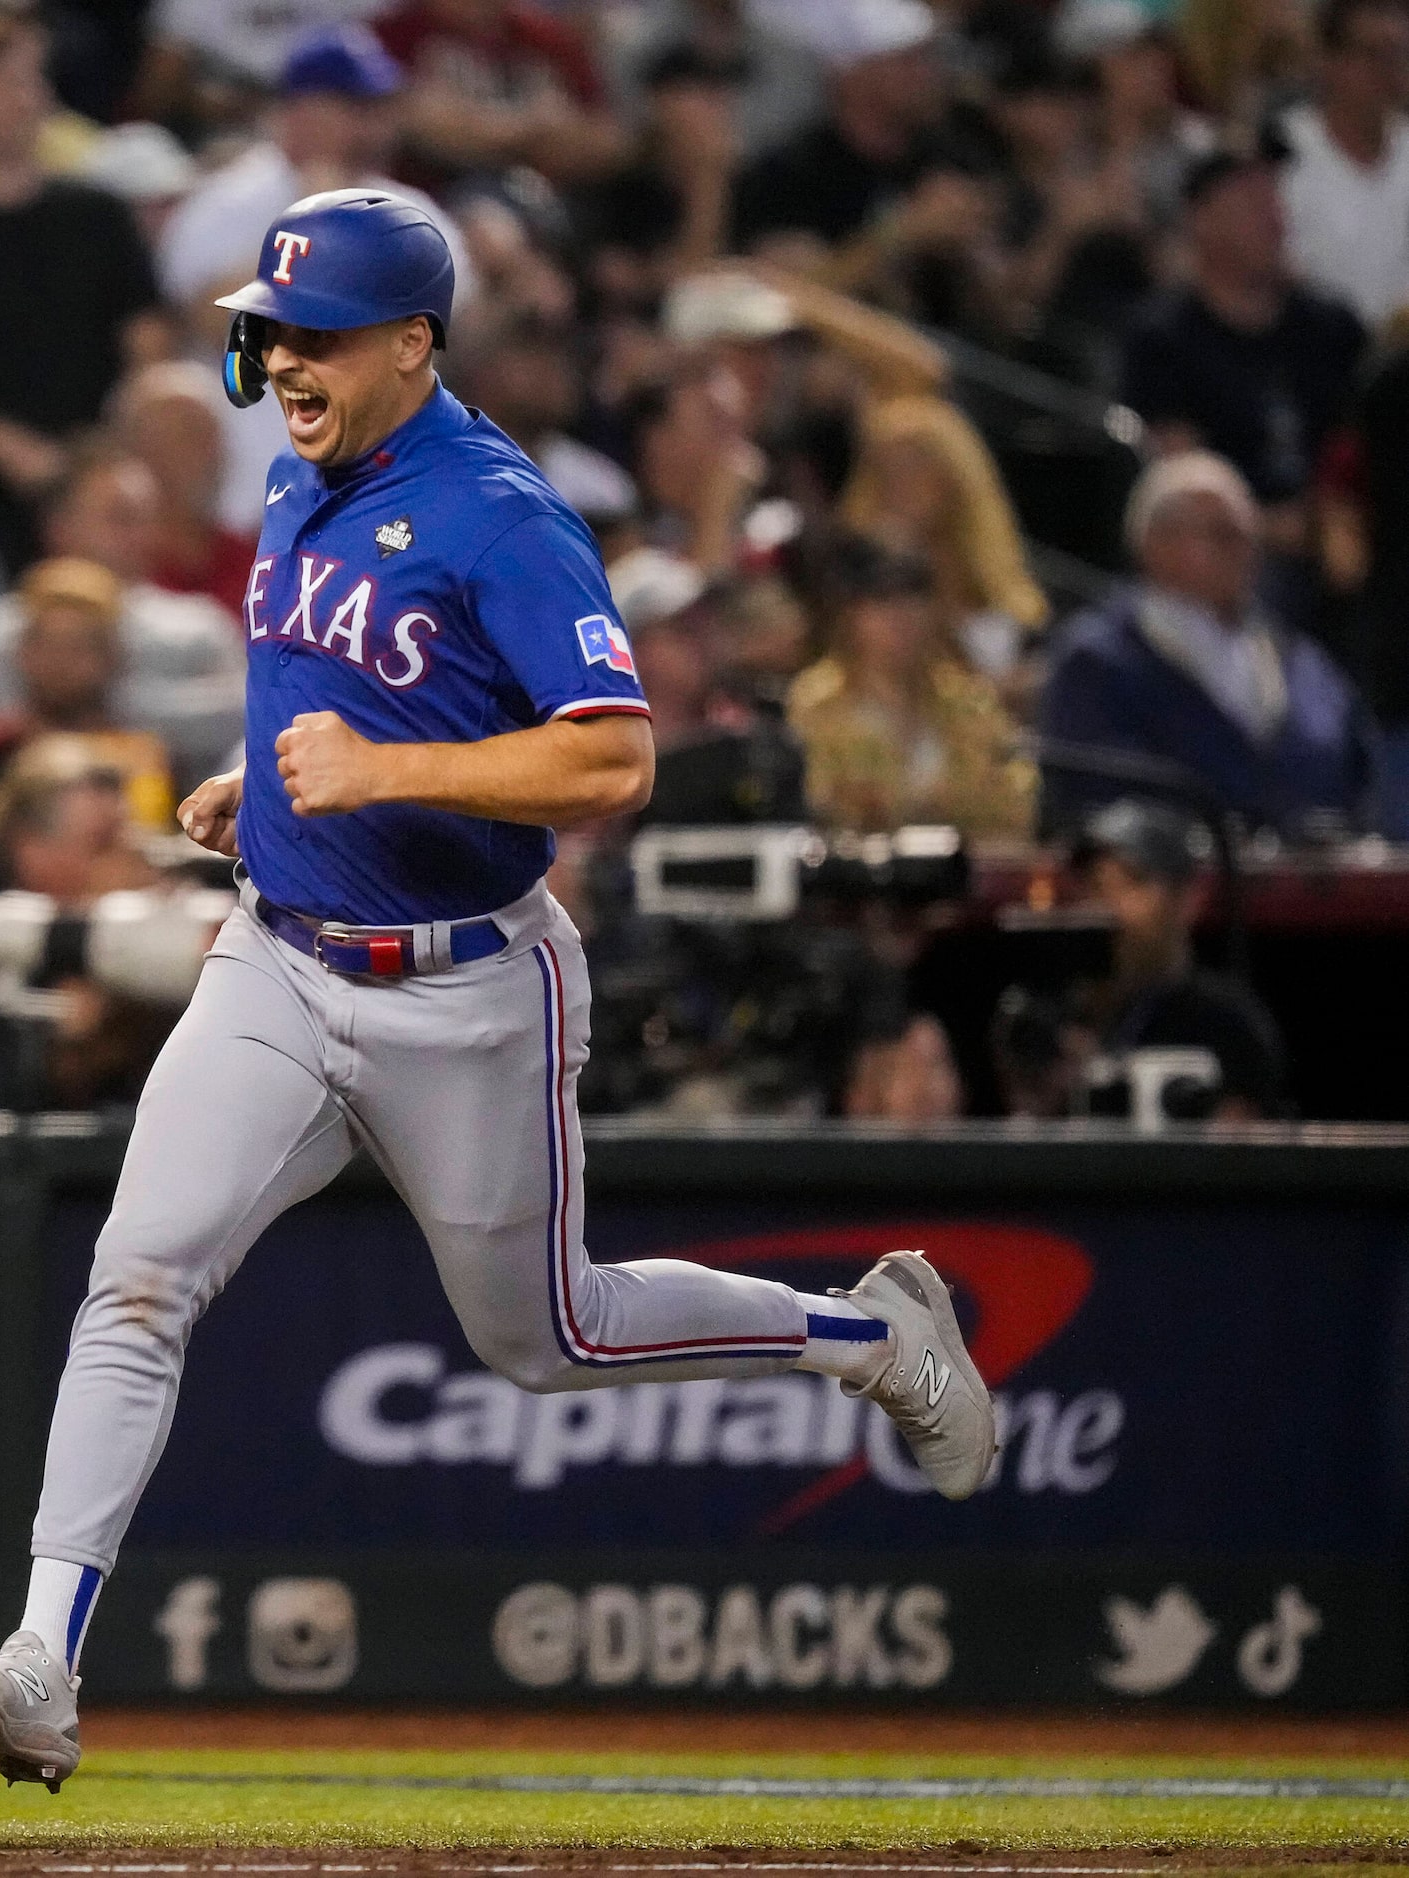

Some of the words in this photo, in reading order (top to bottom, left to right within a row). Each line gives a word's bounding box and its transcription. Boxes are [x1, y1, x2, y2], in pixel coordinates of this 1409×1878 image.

[273, 230, 312, 286] T
[375, 531, 407, 551] SERIES
[380, 524, 412, 544] WORLD
[244, 552, 441, 690] EXAS
[493, 1579, 954, 1689] @DBACKS
